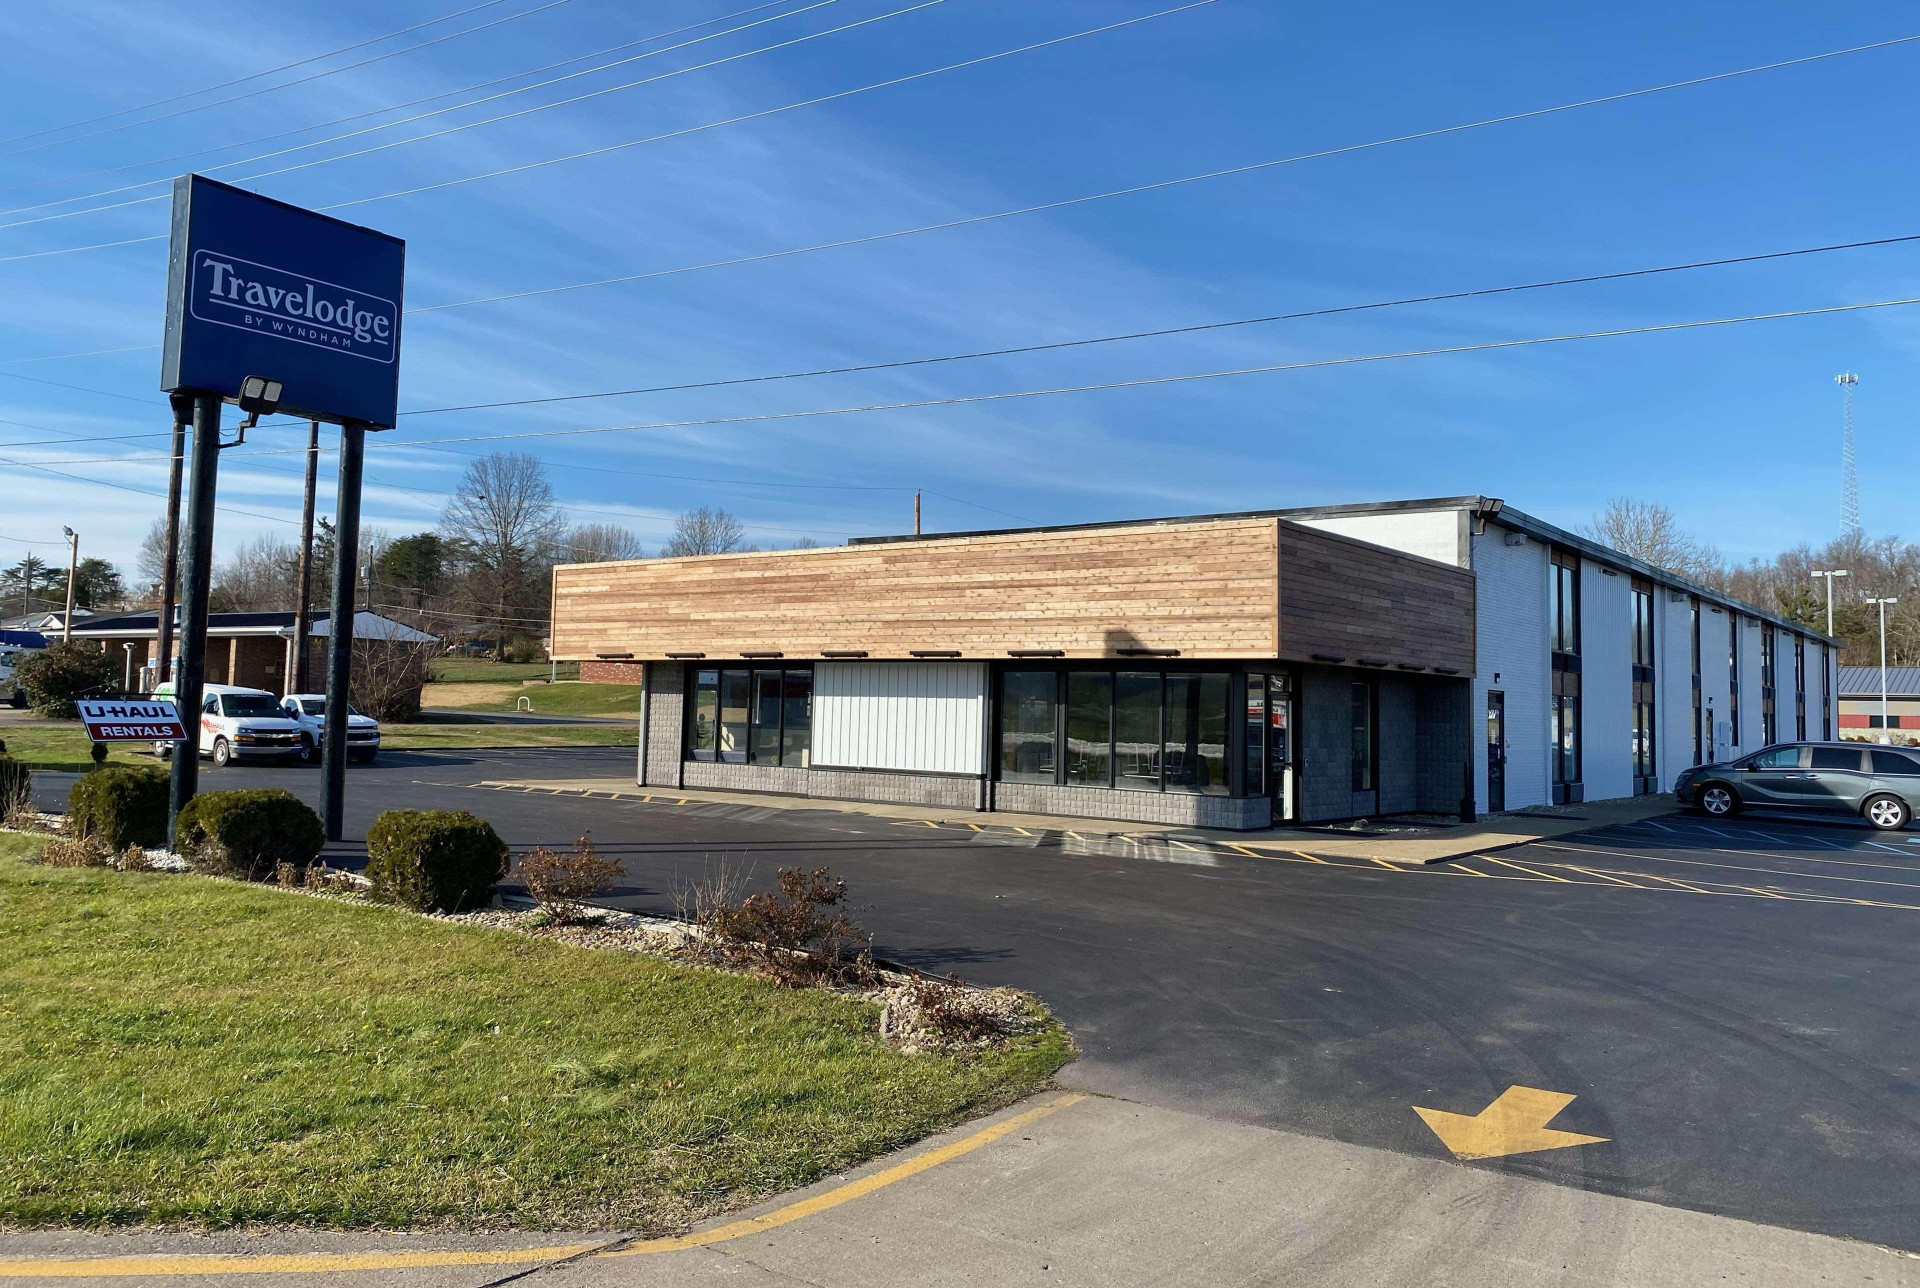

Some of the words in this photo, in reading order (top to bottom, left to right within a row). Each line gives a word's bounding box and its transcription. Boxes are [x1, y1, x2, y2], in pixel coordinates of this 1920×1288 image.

[203, 258, 389, 343] Travelodge
[245, 314, 263, 326] BY
[272, 320, 351, 347] WYNDHAM
[83, 705, 174, 718] U-HAUL
[100, 726, 173, 737] RENTALS
